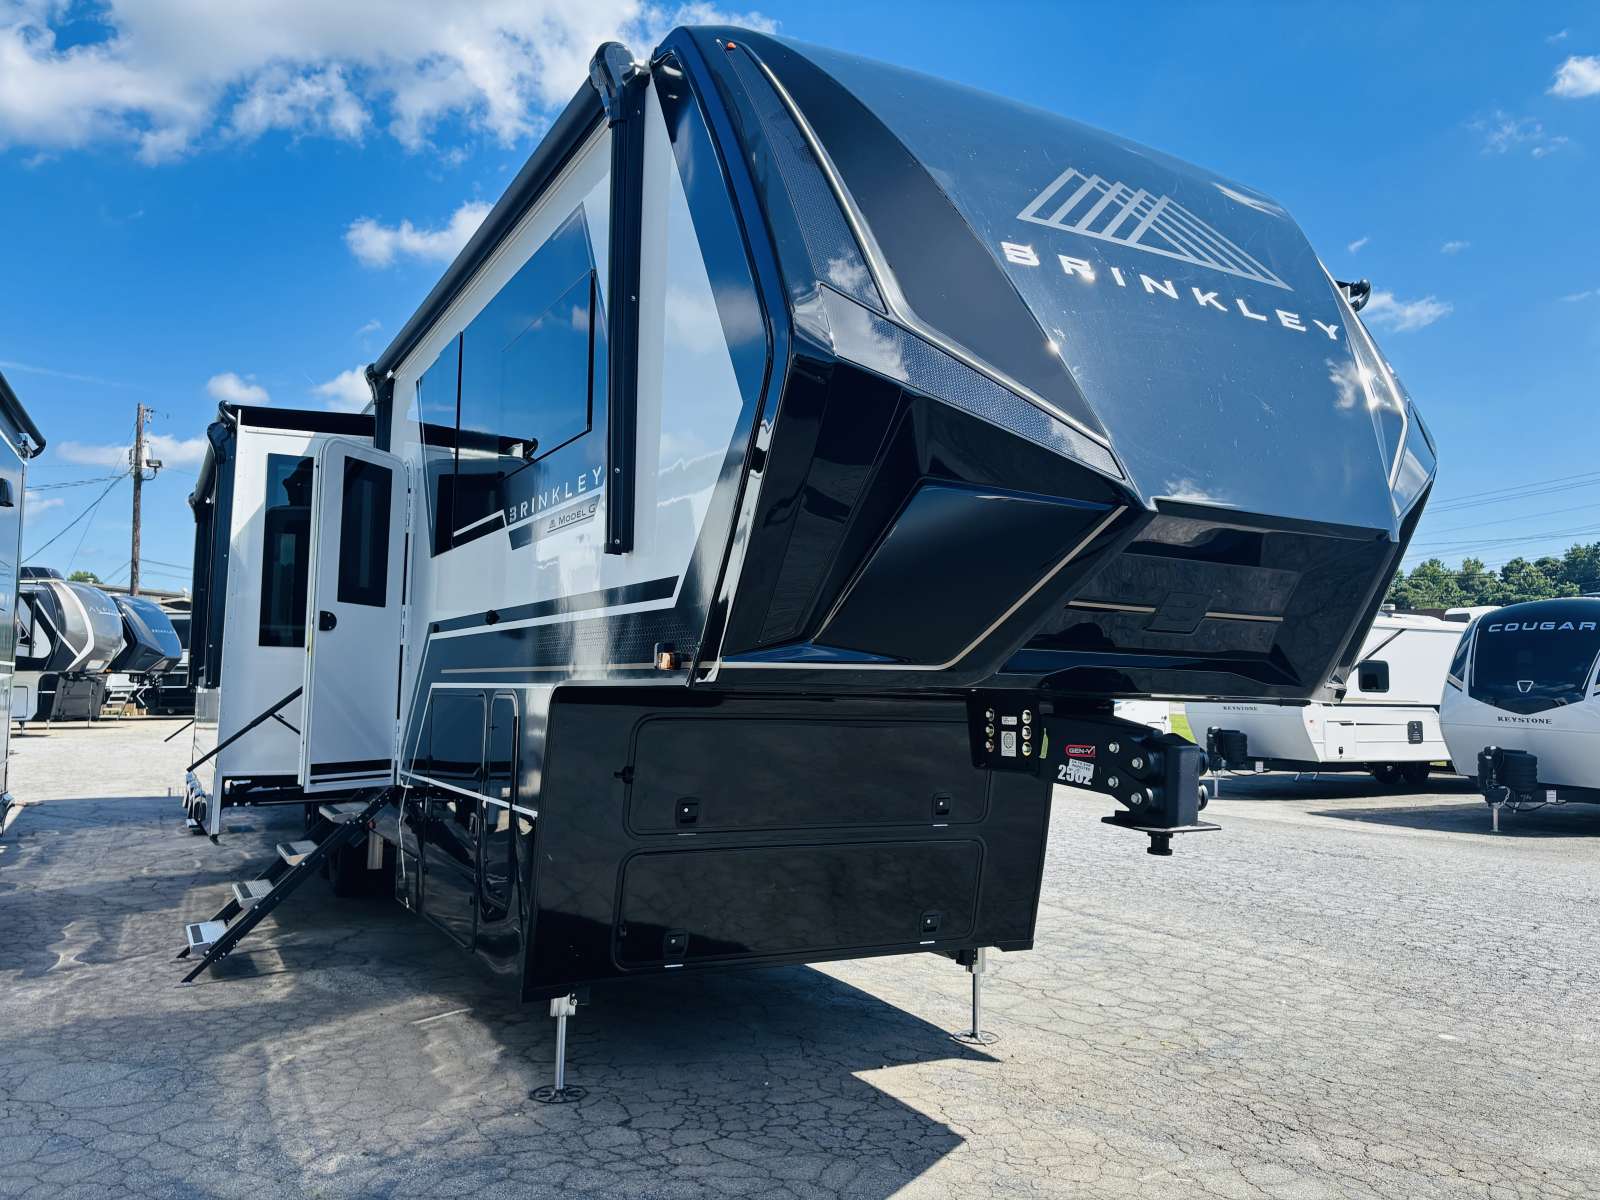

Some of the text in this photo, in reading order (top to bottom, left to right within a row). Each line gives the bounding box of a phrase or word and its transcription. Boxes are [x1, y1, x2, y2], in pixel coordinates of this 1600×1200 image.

[1000, 240, 1340, 341] BRINKLEY
[509, 465, 602, 523] BRINKLEY
[1488, 621, 1597, 632] COUGAR
[1497, 716, 1552, 725] KEYSTONE
